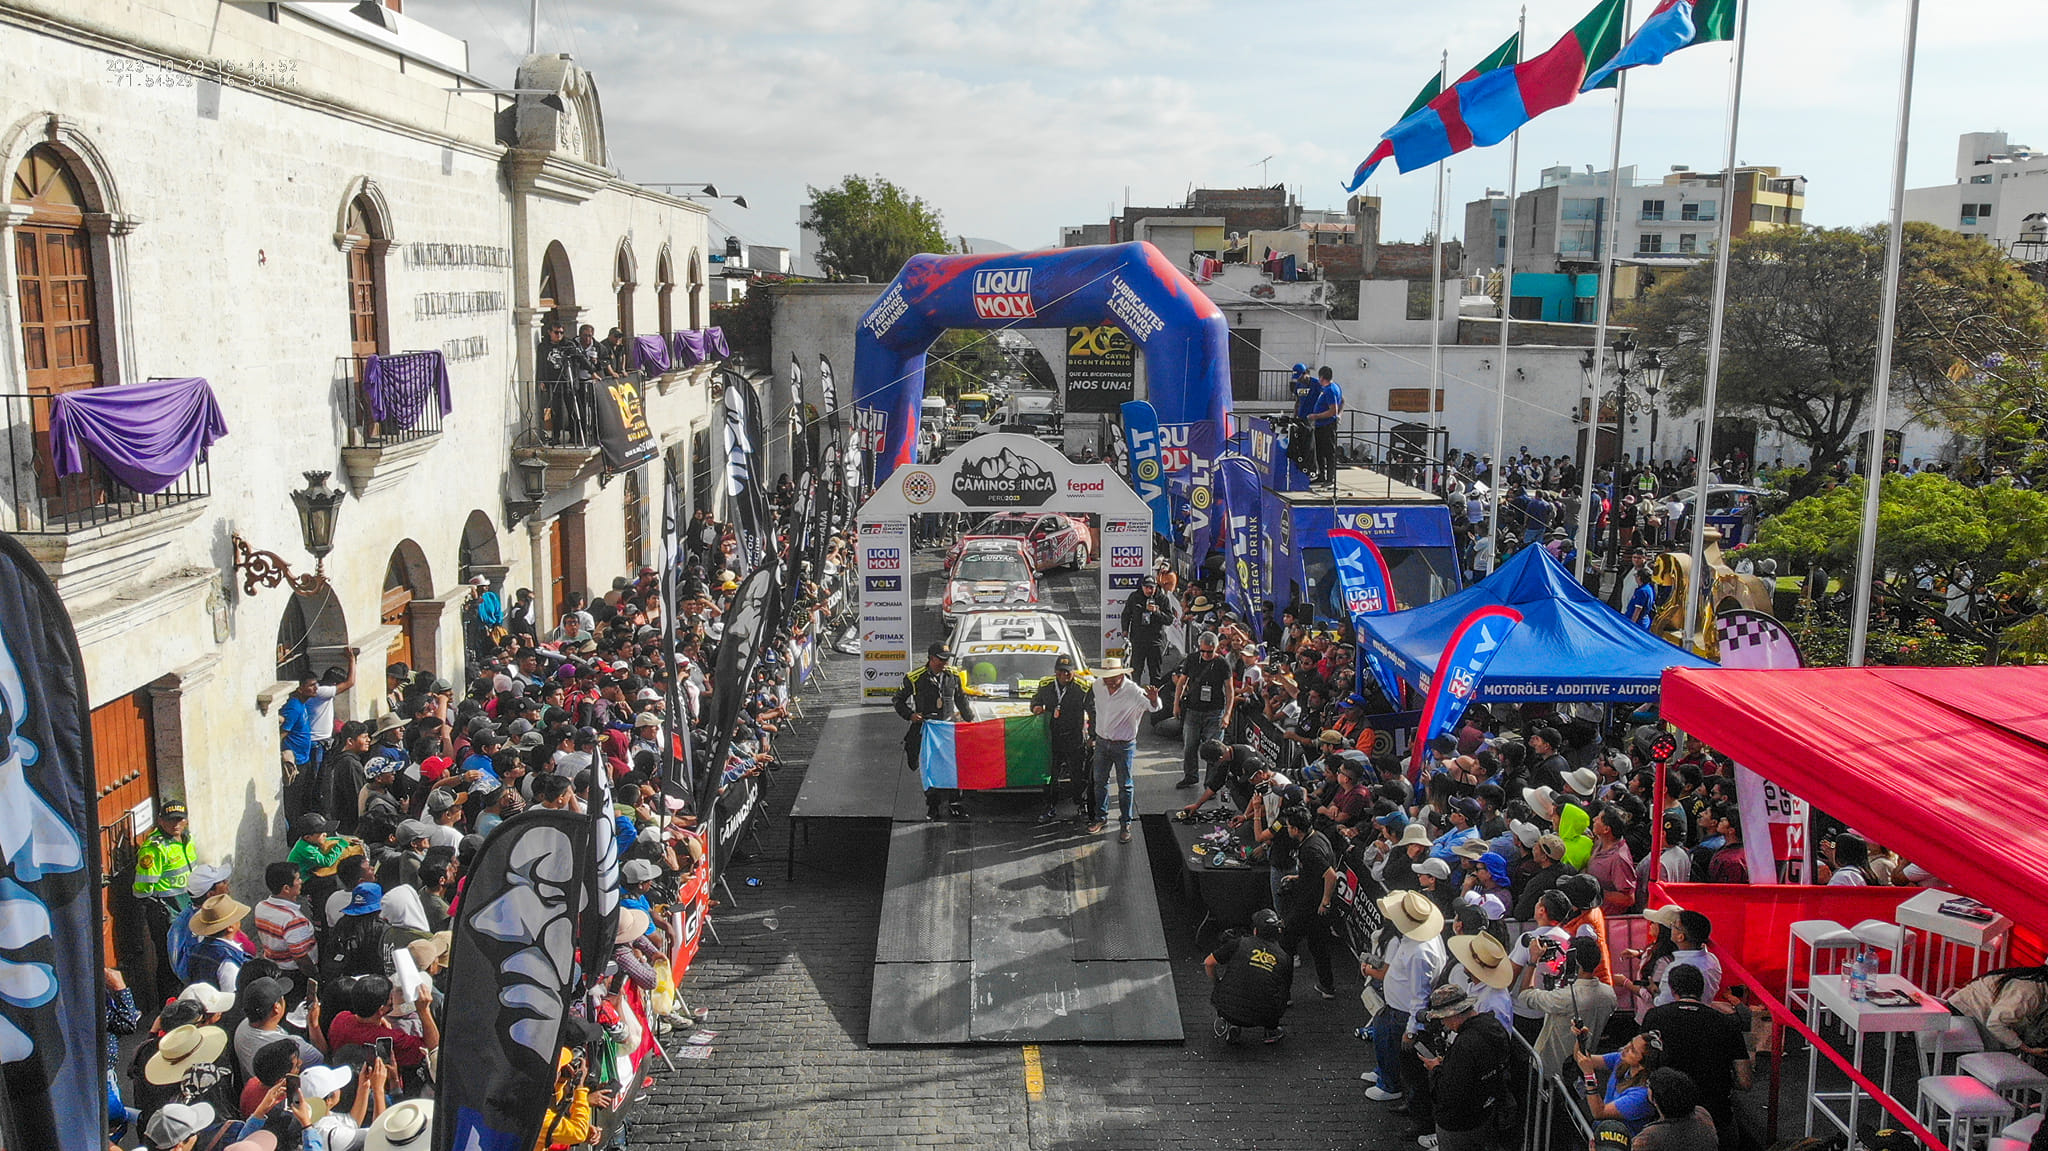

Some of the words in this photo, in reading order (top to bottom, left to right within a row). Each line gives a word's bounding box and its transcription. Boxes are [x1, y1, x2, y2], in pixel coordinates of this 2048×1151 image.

[976, 270, 1029, 293] LIQUI
[863, 282, 903, 329] LUBRICANTES
[869, 321, 877, 331] Y
[875, 294, 904, 327] ADITIVOS
[976, 295, 1033, 317] MOLY
[1111, 275, 1165, 332] LUBRICANTES
[1111, 288, 1120, 299] Y
[1116, 295, 1154, 334] ADITIVOS
[874, 302, 910, 339] ALEMANES
[1106, 299, 1148, 342] ALEMANES
[1068, 381, 1098, 391] ¡NOS
[1101, 380, 1132, 391] UNA!
[1251, 429, 1273, 464] VOLT
[1131, 427, 1163, 503] VOLT
[1066, 478, 1104, 493] fepad
[1191, 452, 1211, 531] VOLT
[1337, 512, 1398, 530] VOLT
[1249, 516, 1258, 556] DRINK
[869, 549, 899, 559] LIQUI
[869, 559, 899, 568] MOLY
[1112, 547, 1142, 557] LIQUI
[1112, 557, 1142, 567] MOLY
[1114, 577, 1140, 585] VOLT
[1251, 562, 1262, 612] ENERGY
[968, 644, 1060, 654] CAYMA
[1484, 682, 1548, 696] MOTORÖLE
[1556, 684, 1611, 695] ADDITIVE
[1353, 896, 1377, 931] GAZOO
[1358, 882, 1381, 924] TOYOTA
[1600, 1130, 1629, 1147] POLICIA
